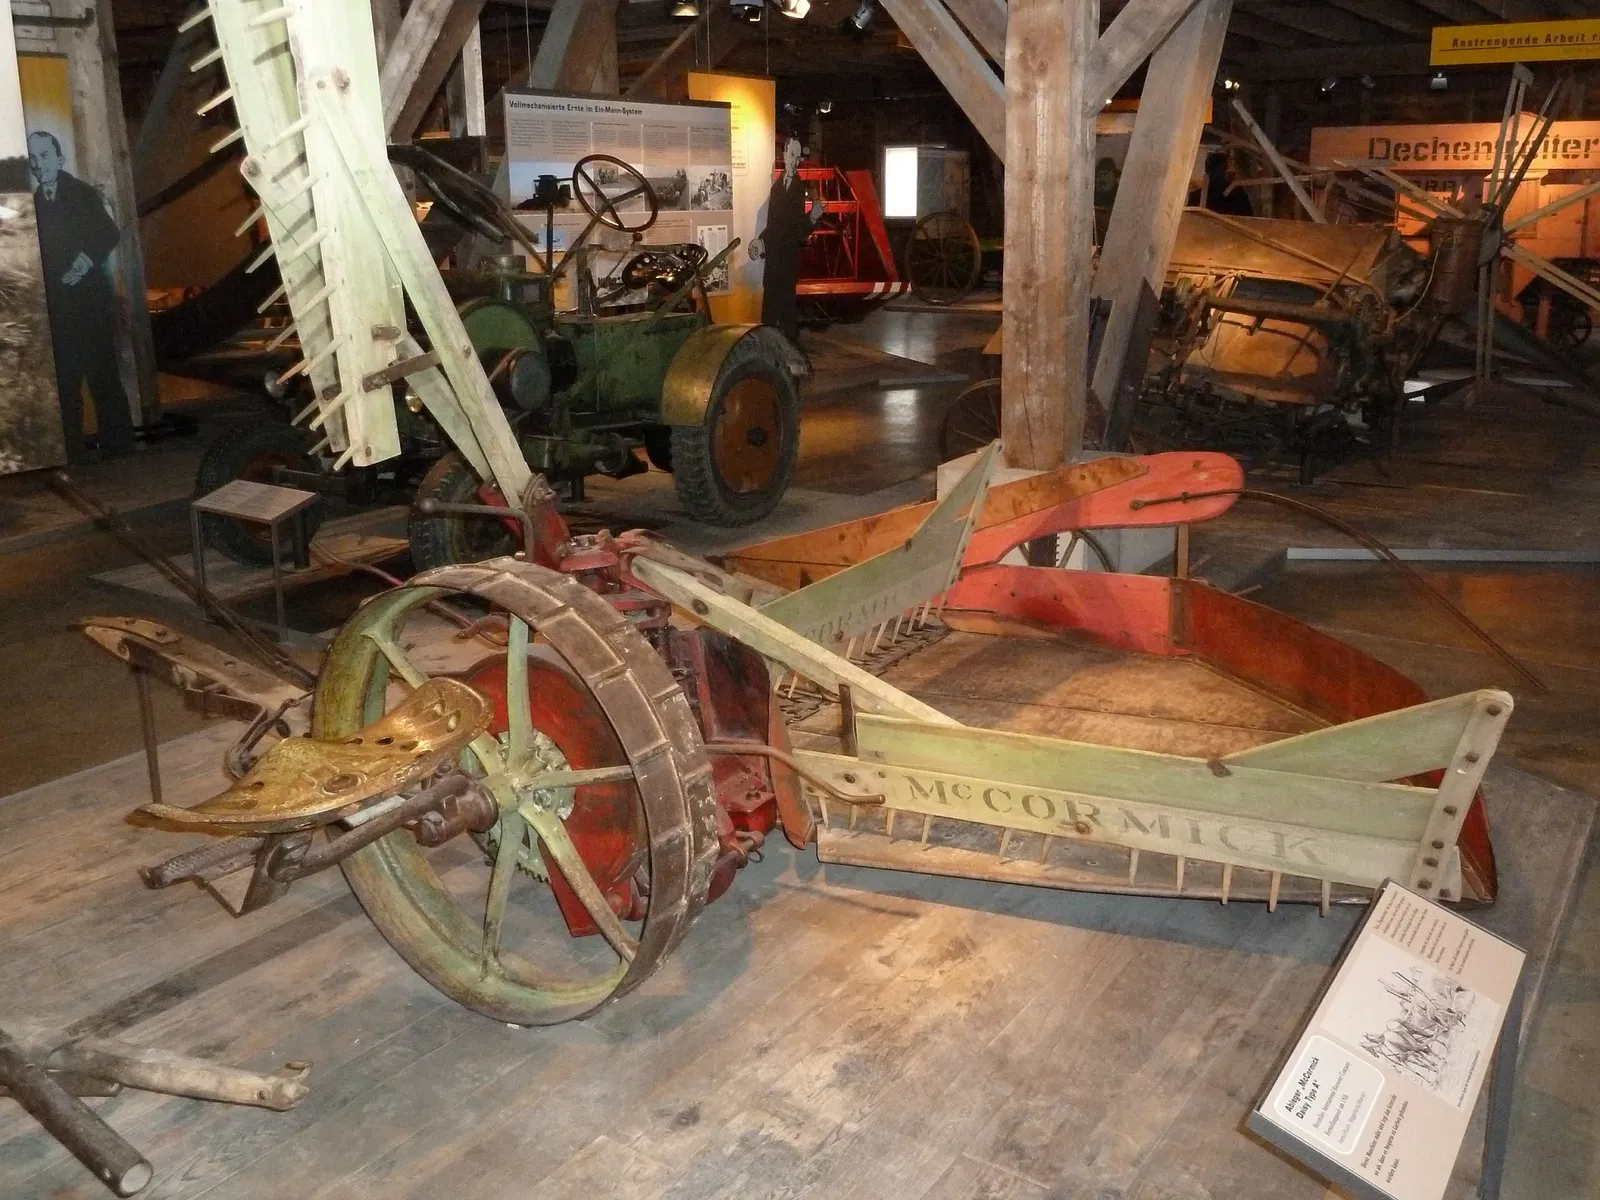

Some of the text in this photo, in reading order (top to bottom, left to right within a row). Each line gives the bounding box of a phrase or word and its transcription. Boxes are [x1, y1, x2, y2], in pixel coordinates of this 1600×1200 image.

[1452, 36, 1538, 48] Anstrengende
[1544, 33, 1586, 44] Arbeit
[509, 100, 565, 111] Vollmechanisierte
[567, 104, 584, 112] Ernte
[595, 105, 643, 116] Ein-Mann-System
[1284, 1089, 1301, 1112] Ableger
[1295, 1103, 1312, 1119] Daisy
[1304, 1088, 1318, 1102] Type
